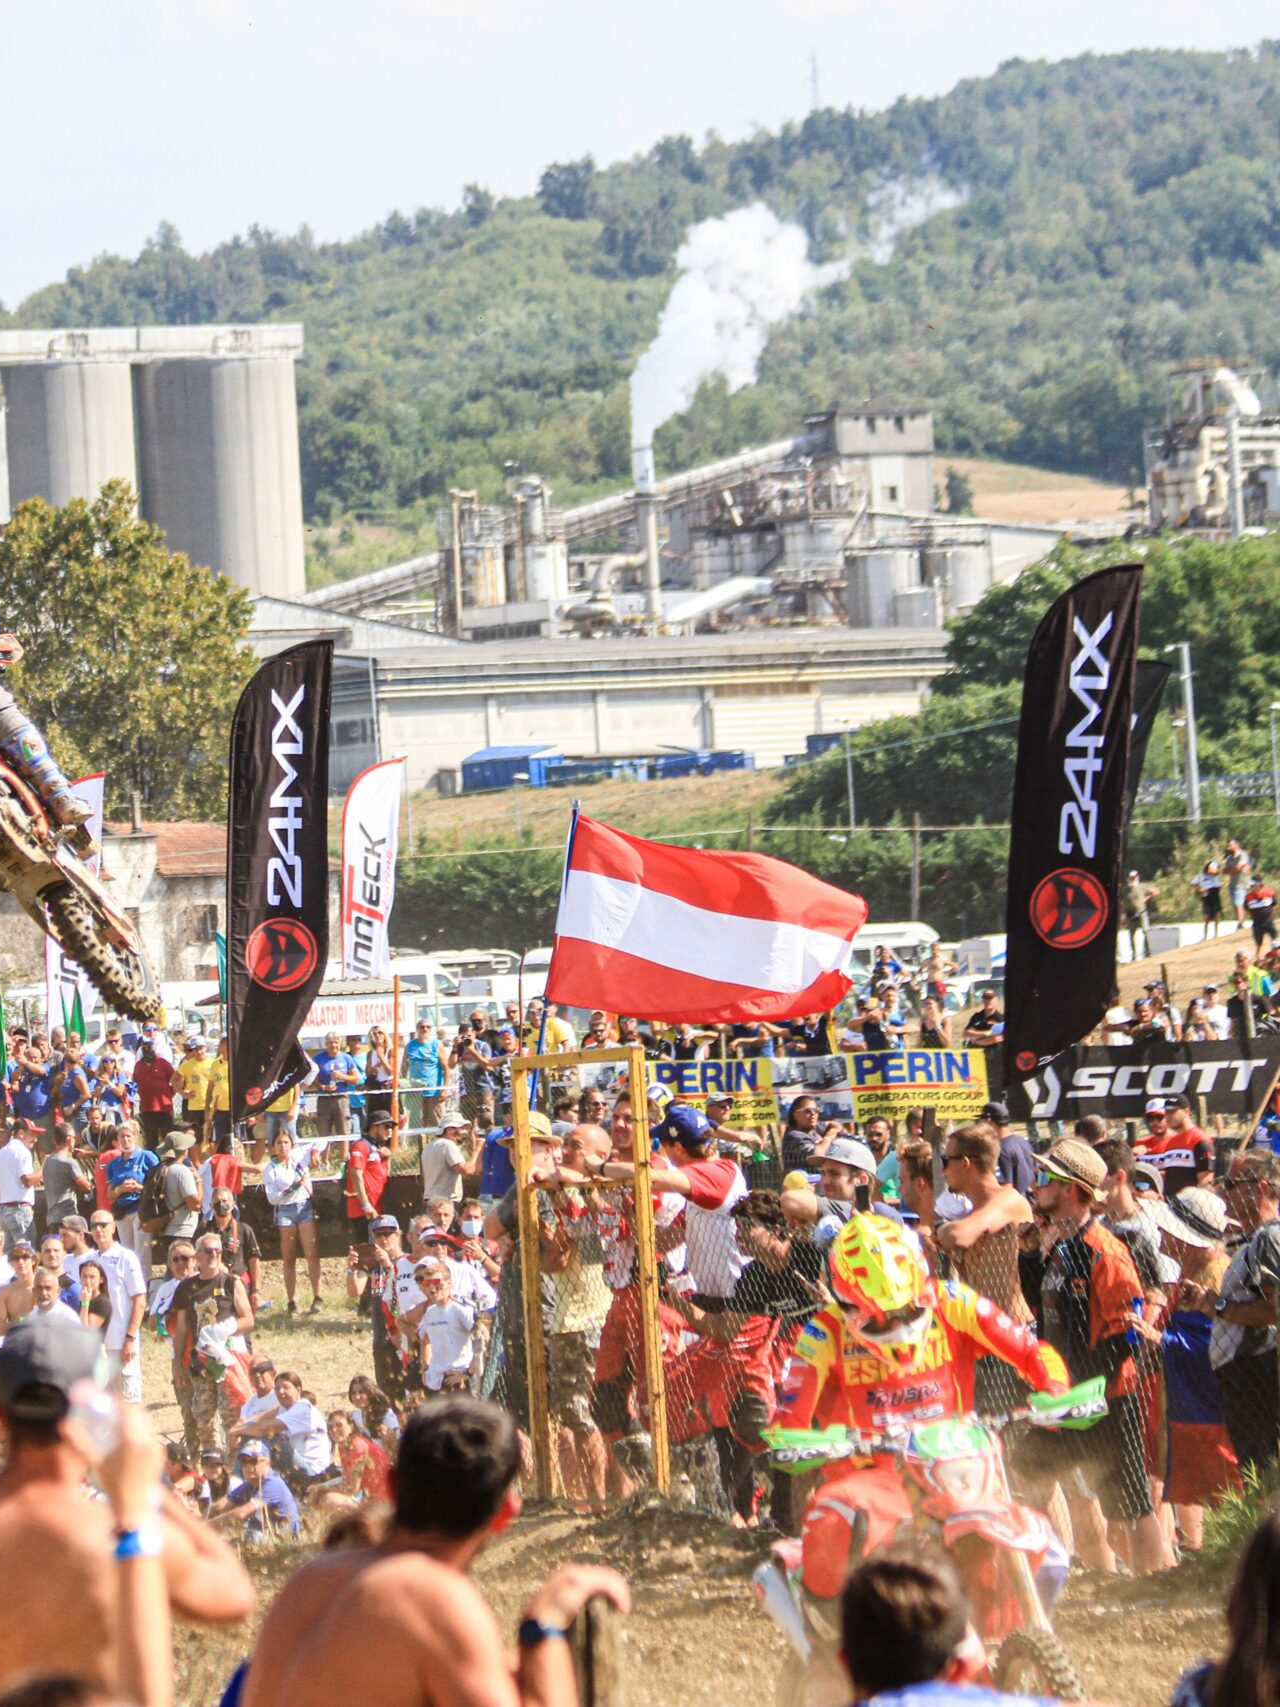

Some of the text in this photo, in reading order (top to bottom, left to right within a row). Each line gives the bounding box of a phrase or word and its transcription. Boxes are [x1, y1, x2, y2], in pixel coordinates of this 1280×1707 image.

[1058, 610, 1114, 859] 24MX
[267, 683, 305, 908] 24MX
[355, 1002, 406, 1025] MECCANCI
[655, 1060, 758, 1093] PERIN
[854, 1051, 971, 1086] PERIN
[1066, 1058, 1268, 1099] SCOTT
[857, 1090, 984, 1104] GENERATORS GROUP
